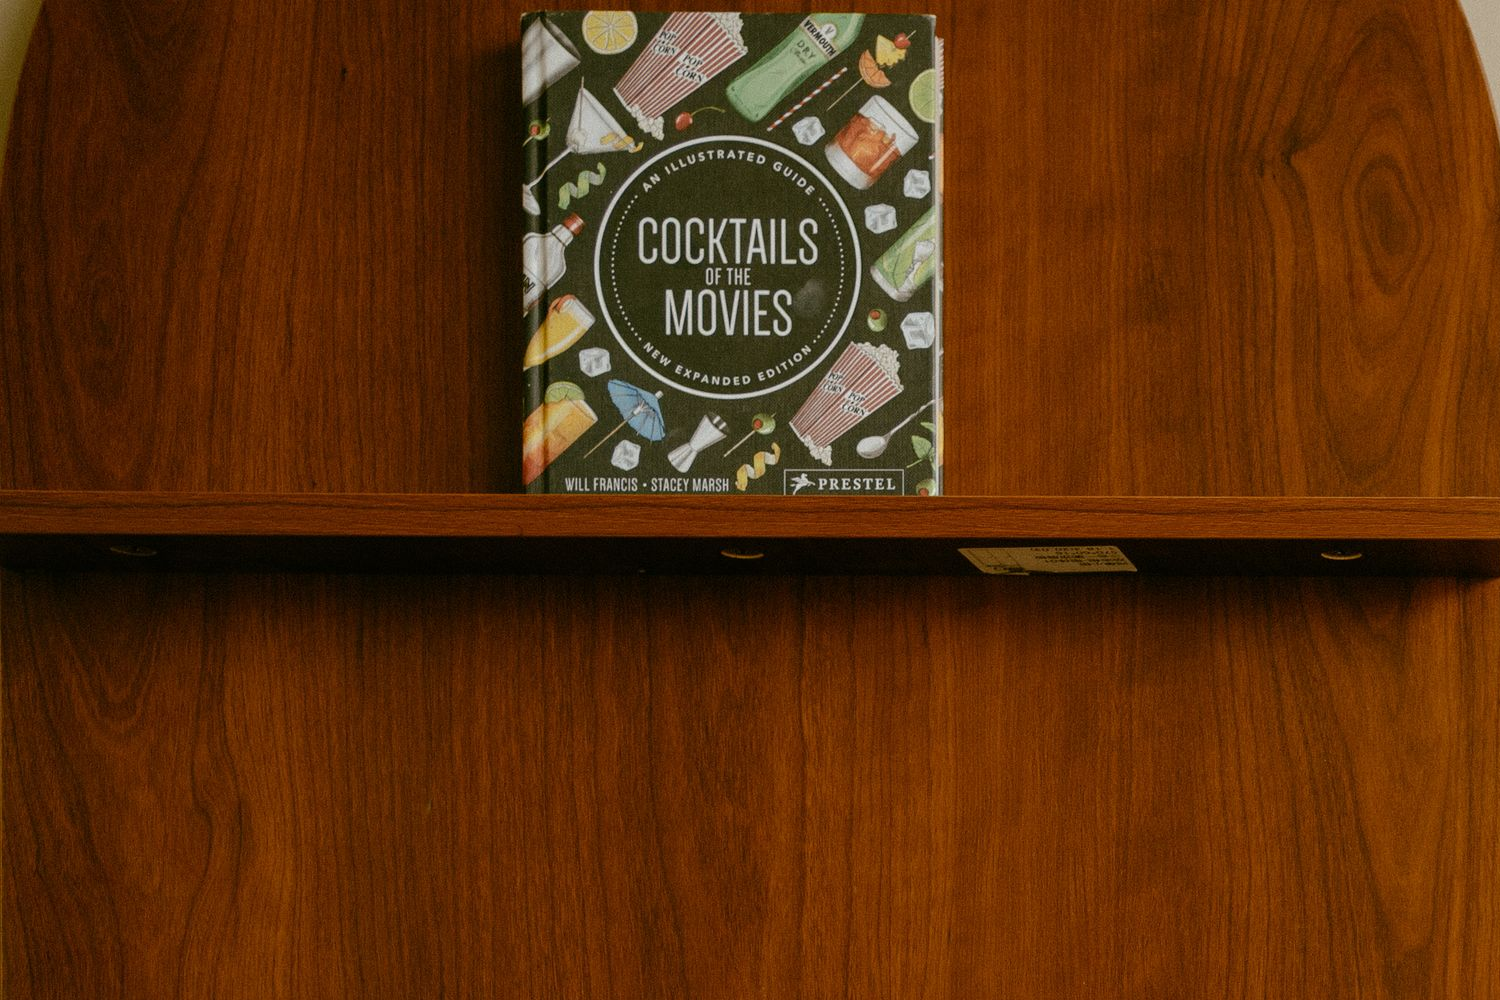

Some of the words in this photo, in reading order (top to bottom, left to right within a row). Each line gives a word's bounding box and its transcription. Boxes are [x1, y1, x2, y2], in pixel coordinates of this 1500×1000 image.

[659, 31, 677, 41] POP
[803, 19, 837, 57] VERMOUTH
[796, 40, 816, 59] DRY
[683, 54, 703, 67] POP
[675, 66, 702, 82] CORN
[642, 173, 661, 193] AN
[664, 149, 767, 175] ILLUSTRATED
[772, 161, 815, 196] GUIDE
[638, 216, 819, 266] COCKTAILS
[705, 267, 722, 286] OF
[726, 267, 752, 286] THE
[664, 288, 793, 337] MOVIES
[643, 342, 672, 367] NEW
[674, 364, 751, 386] EXPANDED
[757, 344, 812, 382] EDITION
[848, 392, 866, 401] POP
[565, 477, 590, 492] WILL
[593, 477, 638, 492] FRANCIS
[651, 477, 690, 492] STACEY
[692, 477, 729, 492] MARSH
[818, 477, 896, 491] PRESTEL
